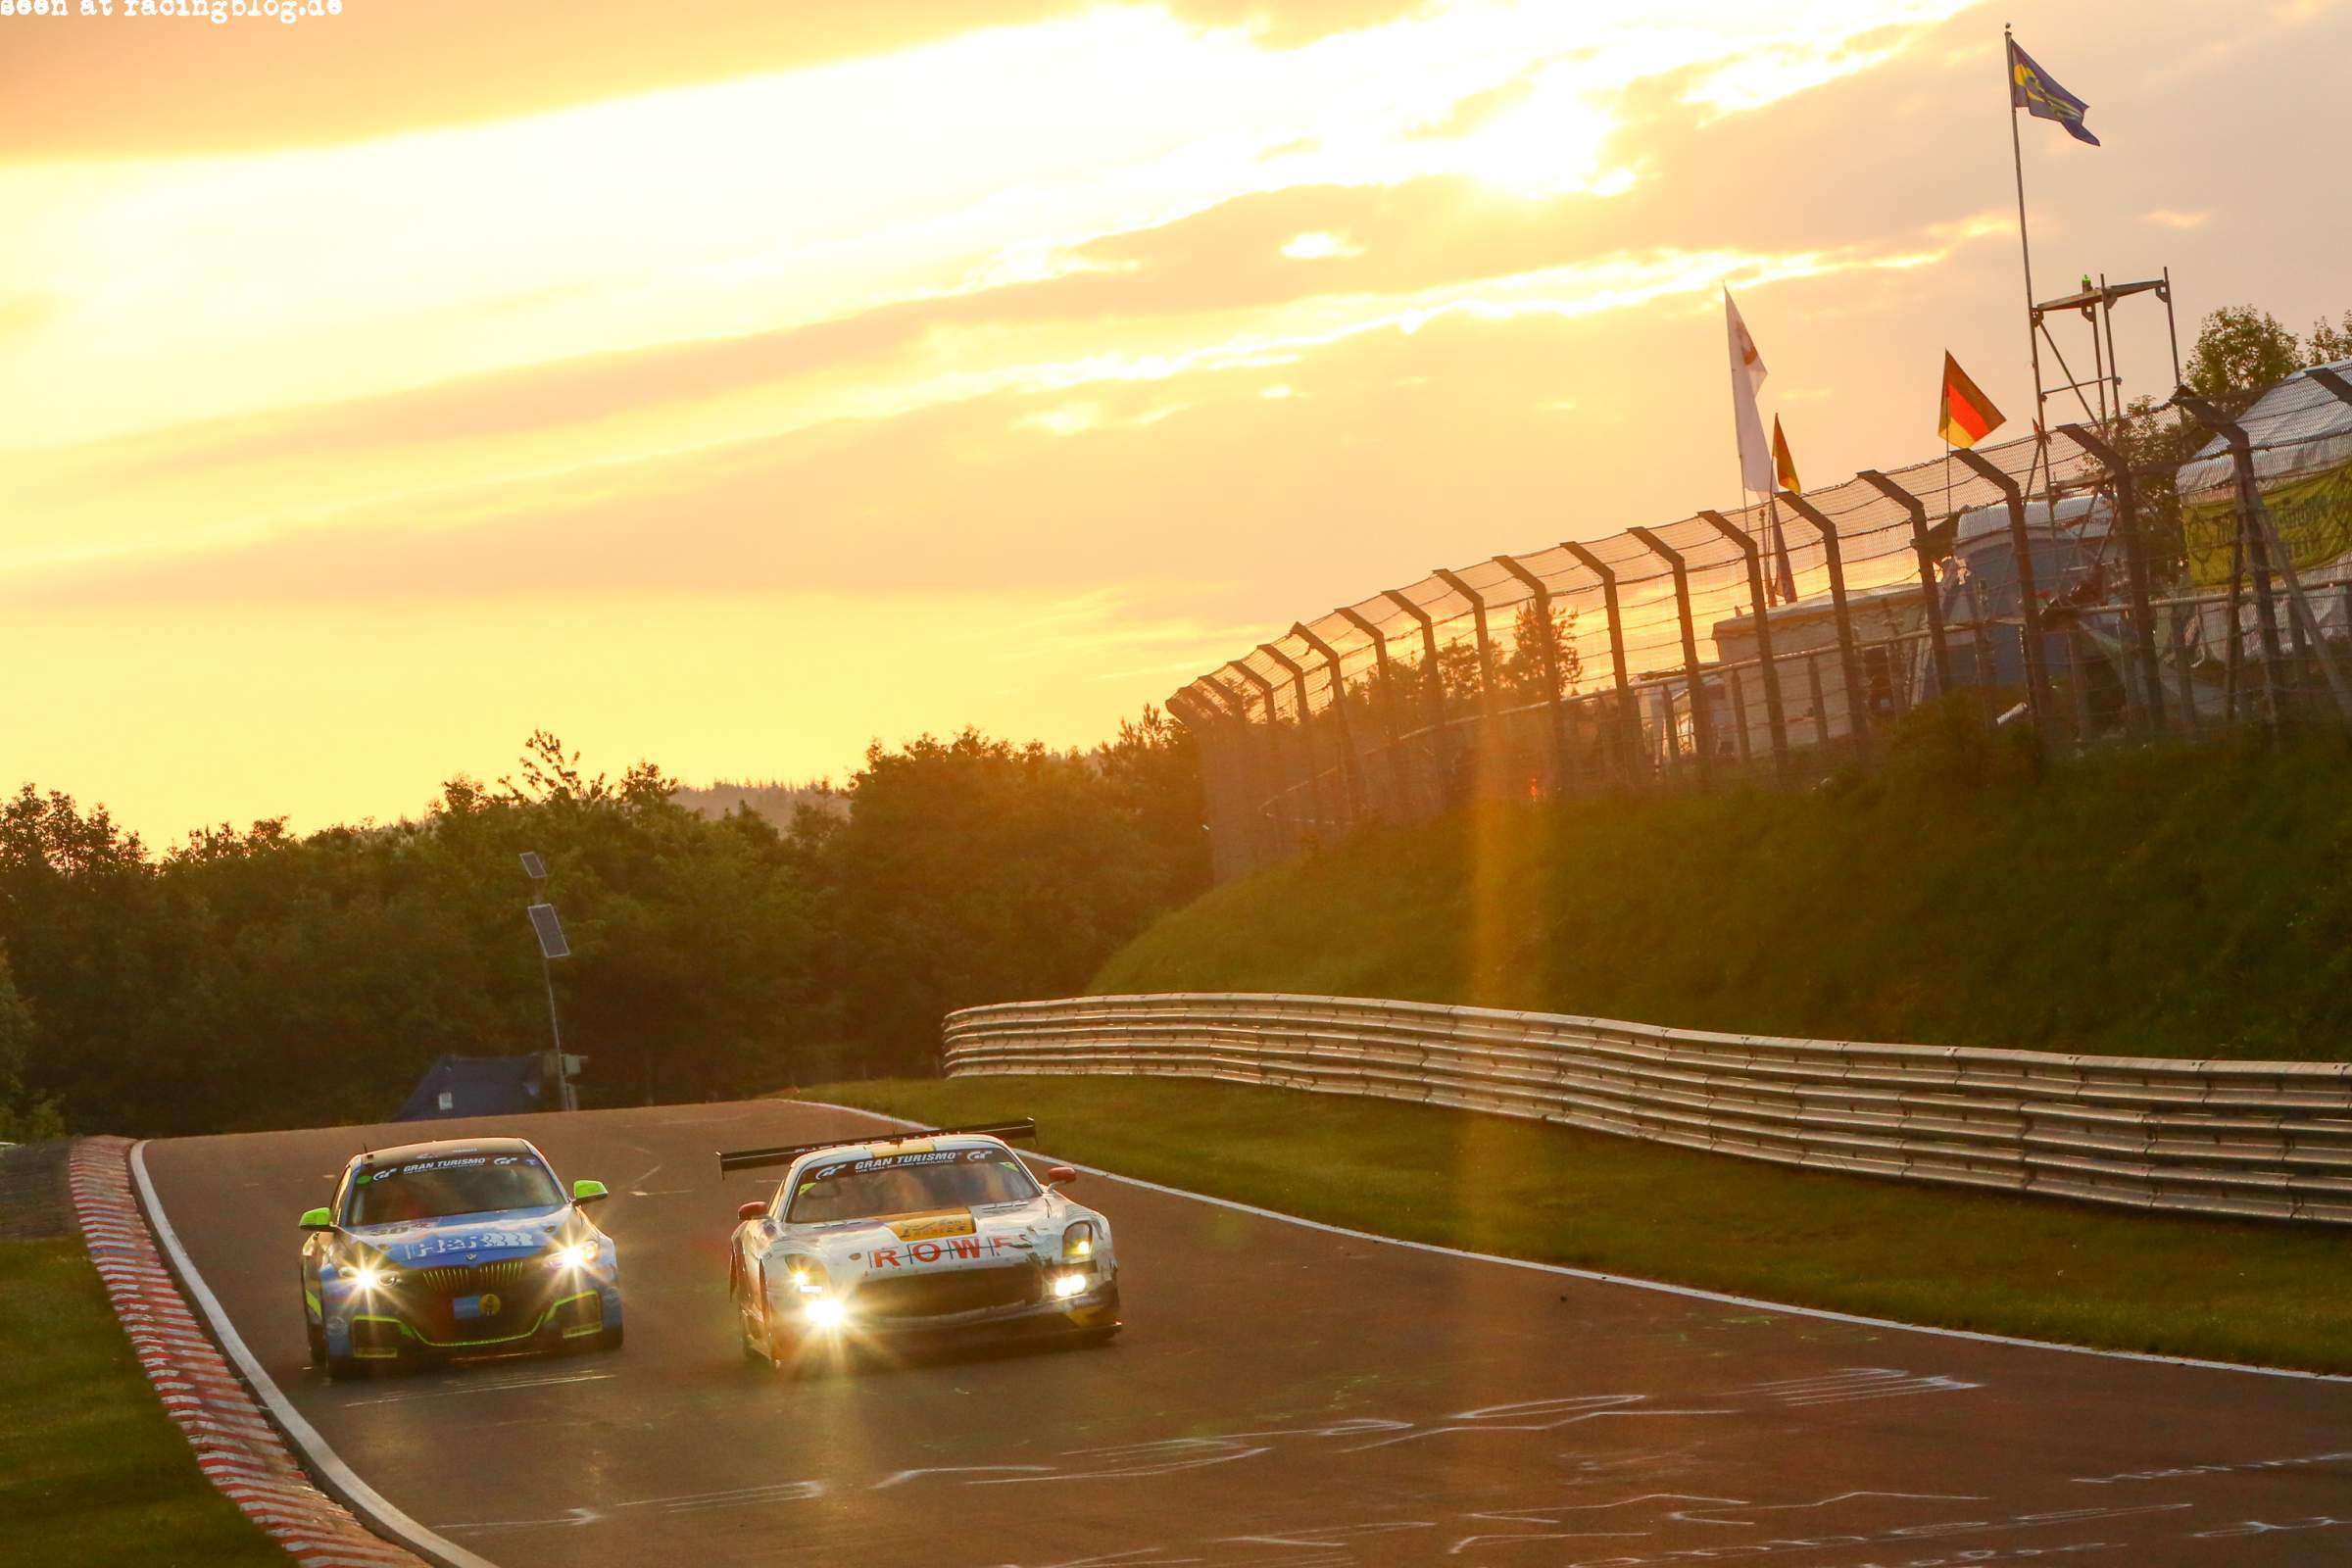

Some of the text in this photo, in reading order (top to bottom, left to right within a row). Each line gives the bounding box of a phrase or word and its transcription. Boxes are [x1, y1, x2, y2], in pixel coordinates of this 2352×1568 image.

[403, 1162, 435, 1172] GRAN
[437, 1157, 486, 1167] TURISMO
[855, 1157, 893, 1170] GRAN
[896, 1152, 956, 1163] TURISMO
